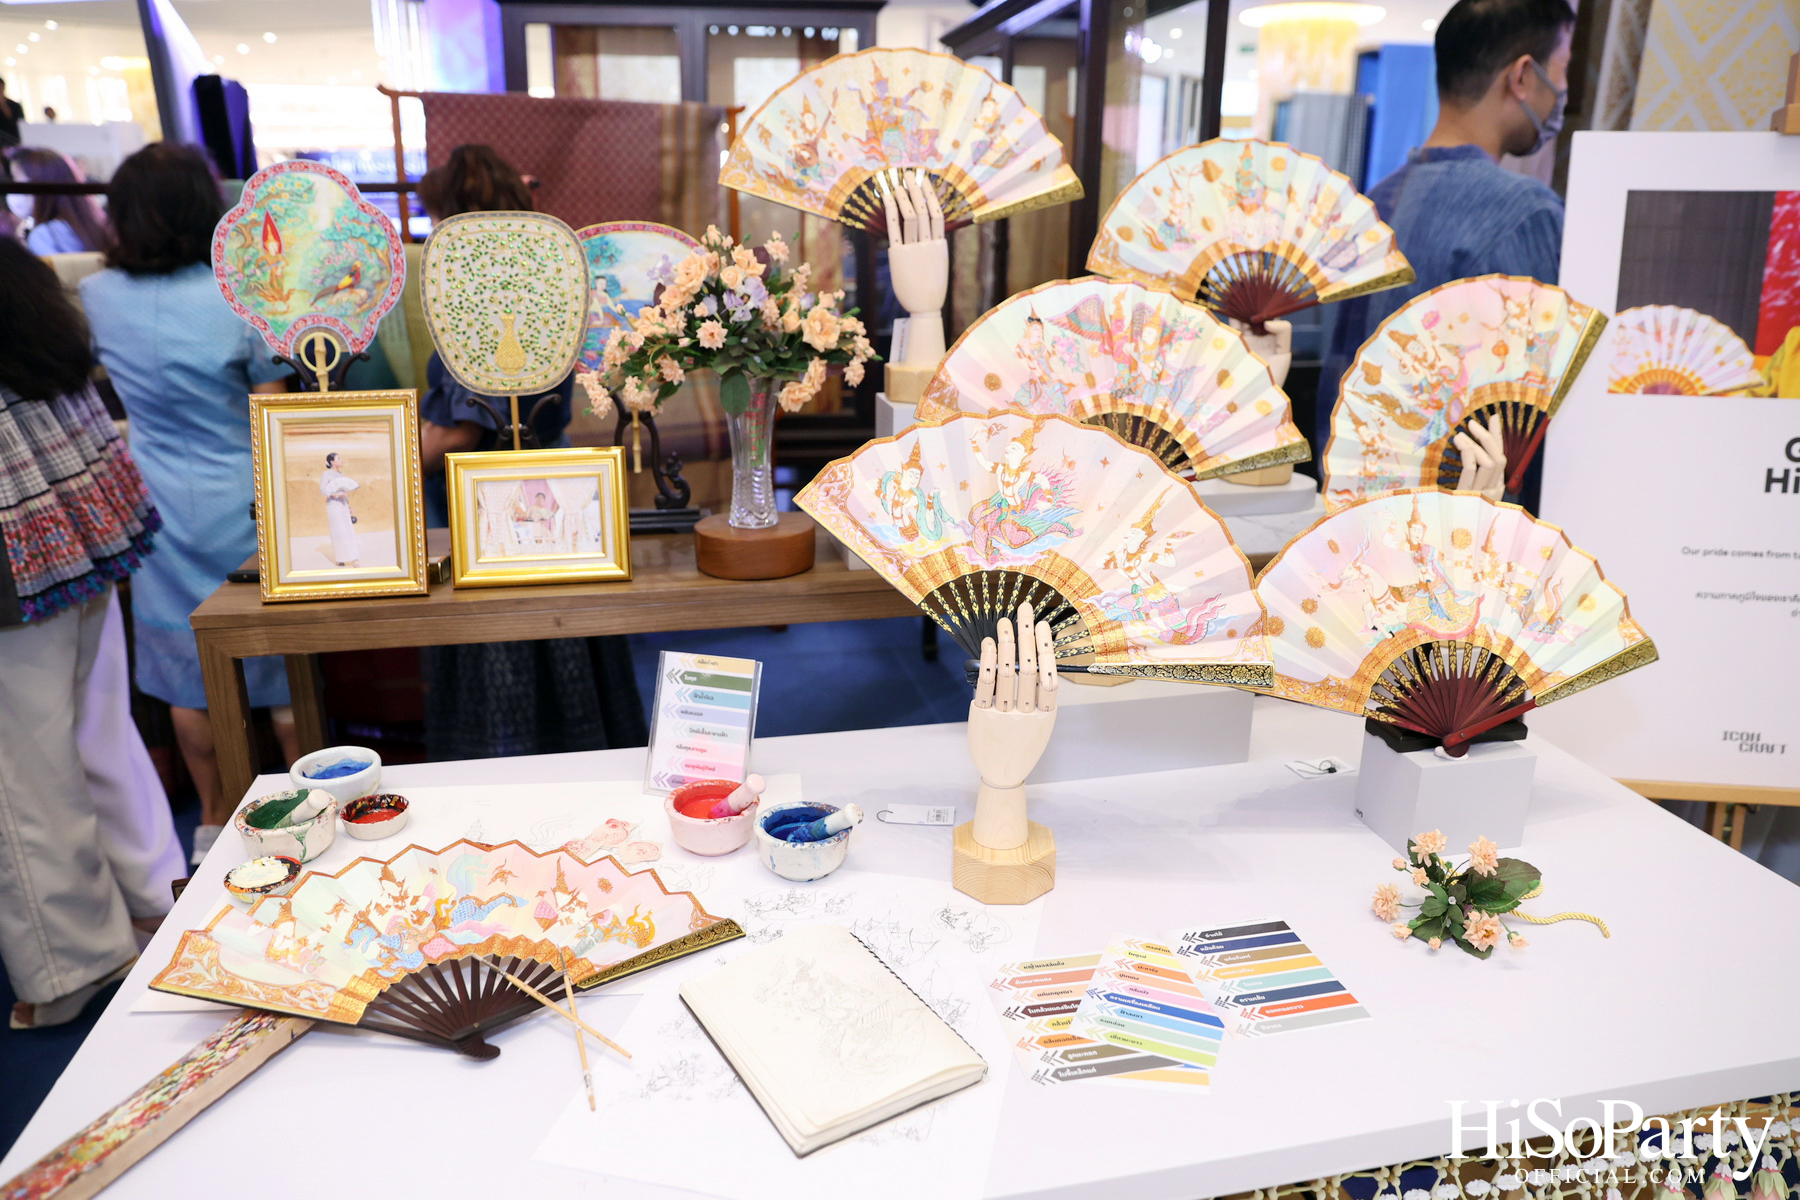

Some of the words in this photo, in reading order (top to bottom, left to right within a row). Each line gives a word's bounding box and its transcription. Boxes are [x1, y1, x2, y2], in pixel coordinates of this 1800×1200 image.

[1681, 546, 1700, 555] Our
[1702, 547, 1729, 557] pride
[1731, 550, 1764, 558] comes
[1766, 550, 1791, 559] from
